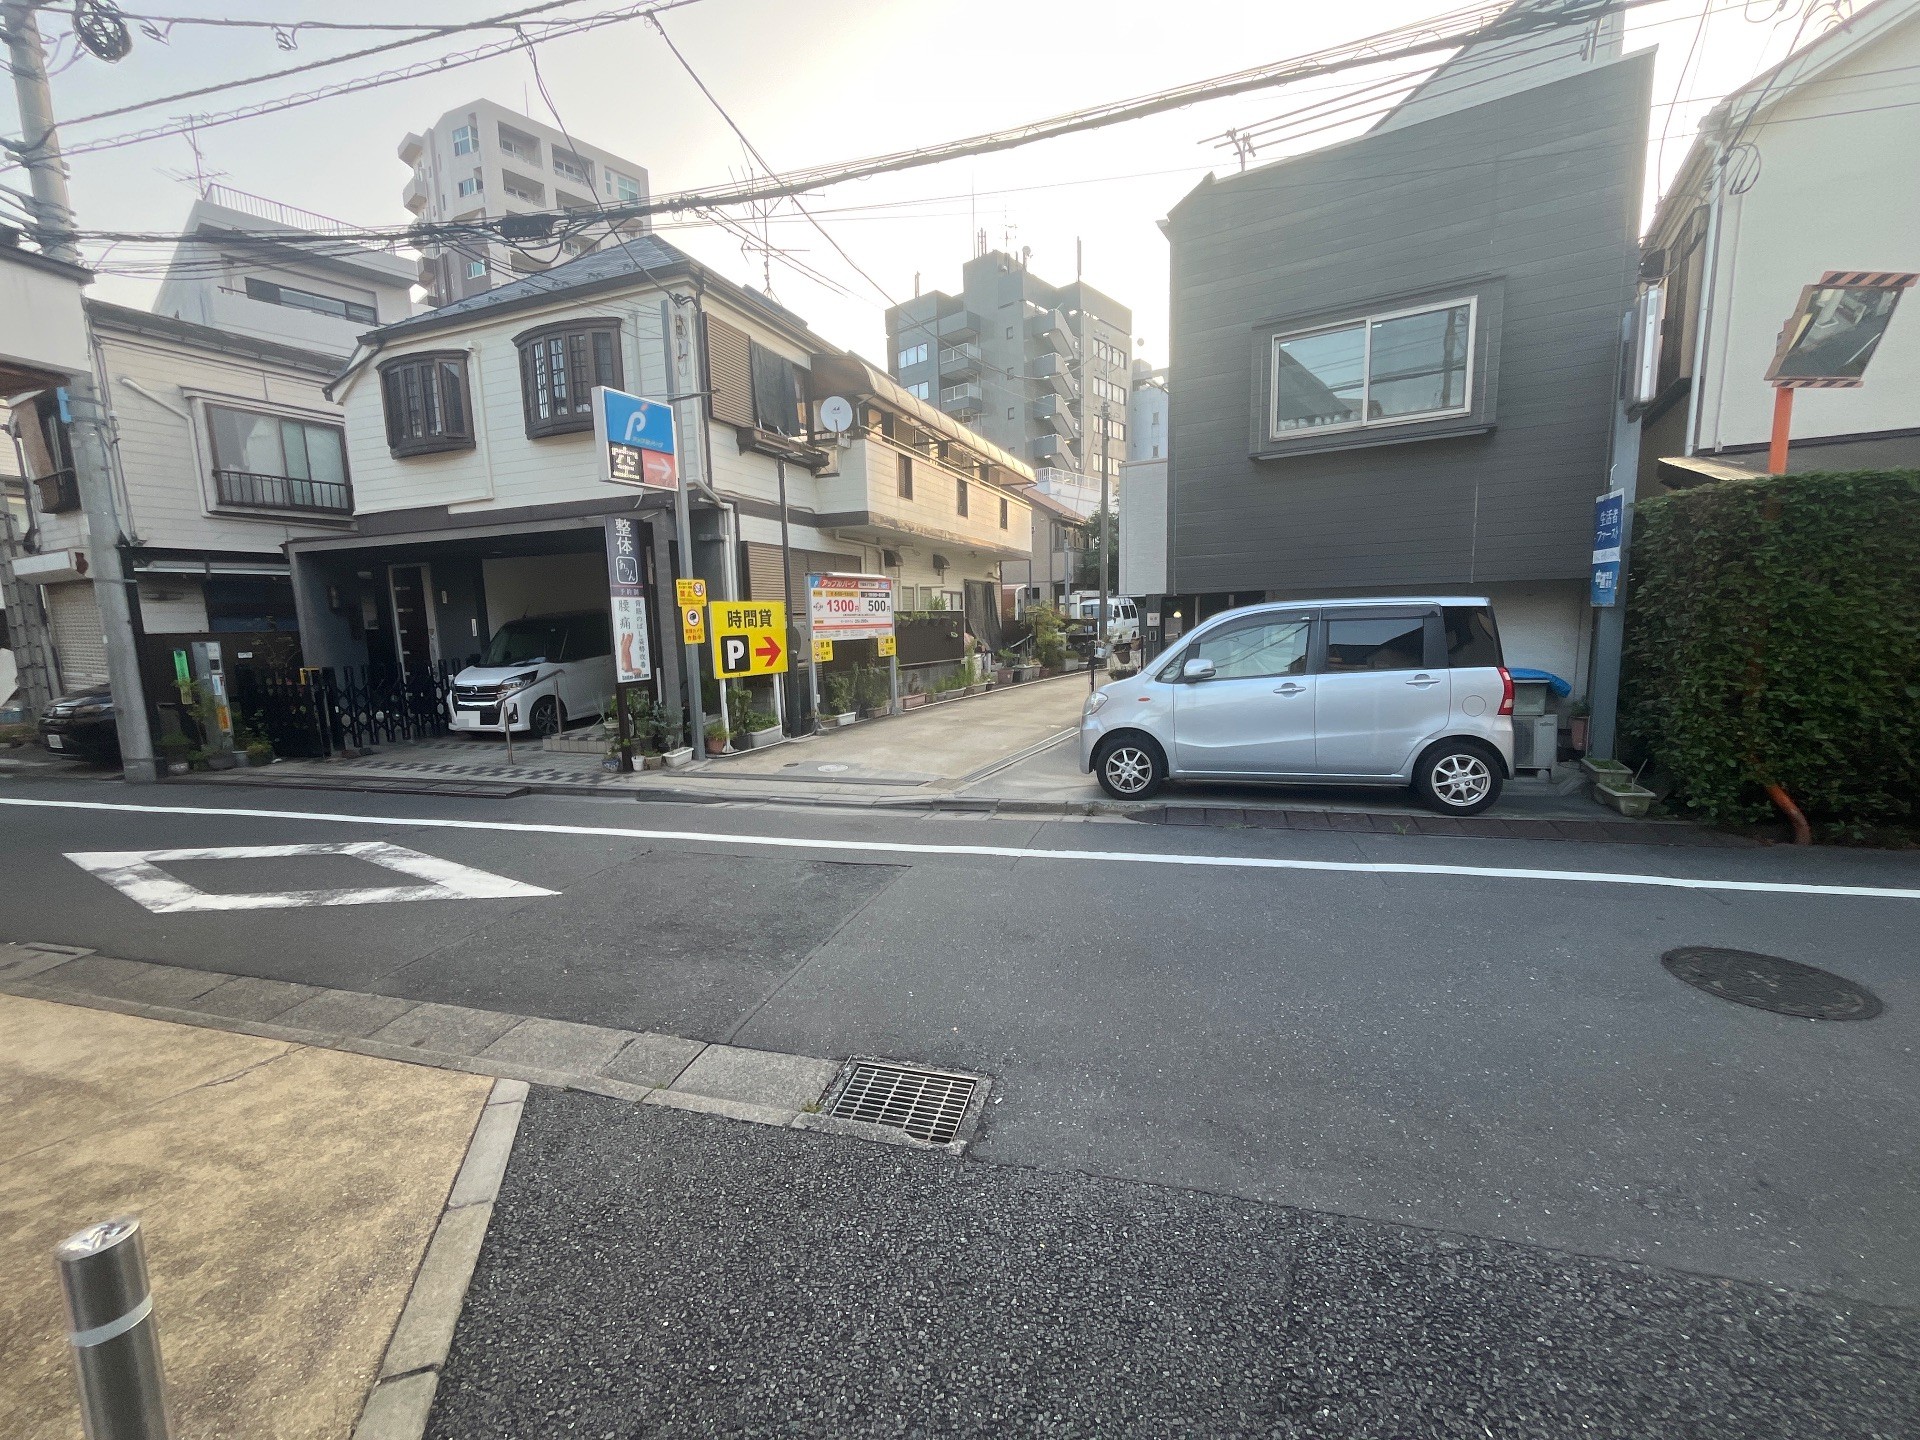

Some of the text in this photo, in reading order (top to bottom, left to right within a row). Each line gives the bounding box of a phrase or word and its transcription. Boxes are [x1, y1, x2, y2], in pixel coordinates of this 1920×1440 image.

[1600, 508, 1619, 527] 生活者
[614, 517, 633, 555] 整体
[1596, 526, 1619, 542] ファースト
[618, 599, 631, 630] 腰痛
[727, 609, 772, 629] 時間貸
[726, 640, 745, 670] P
